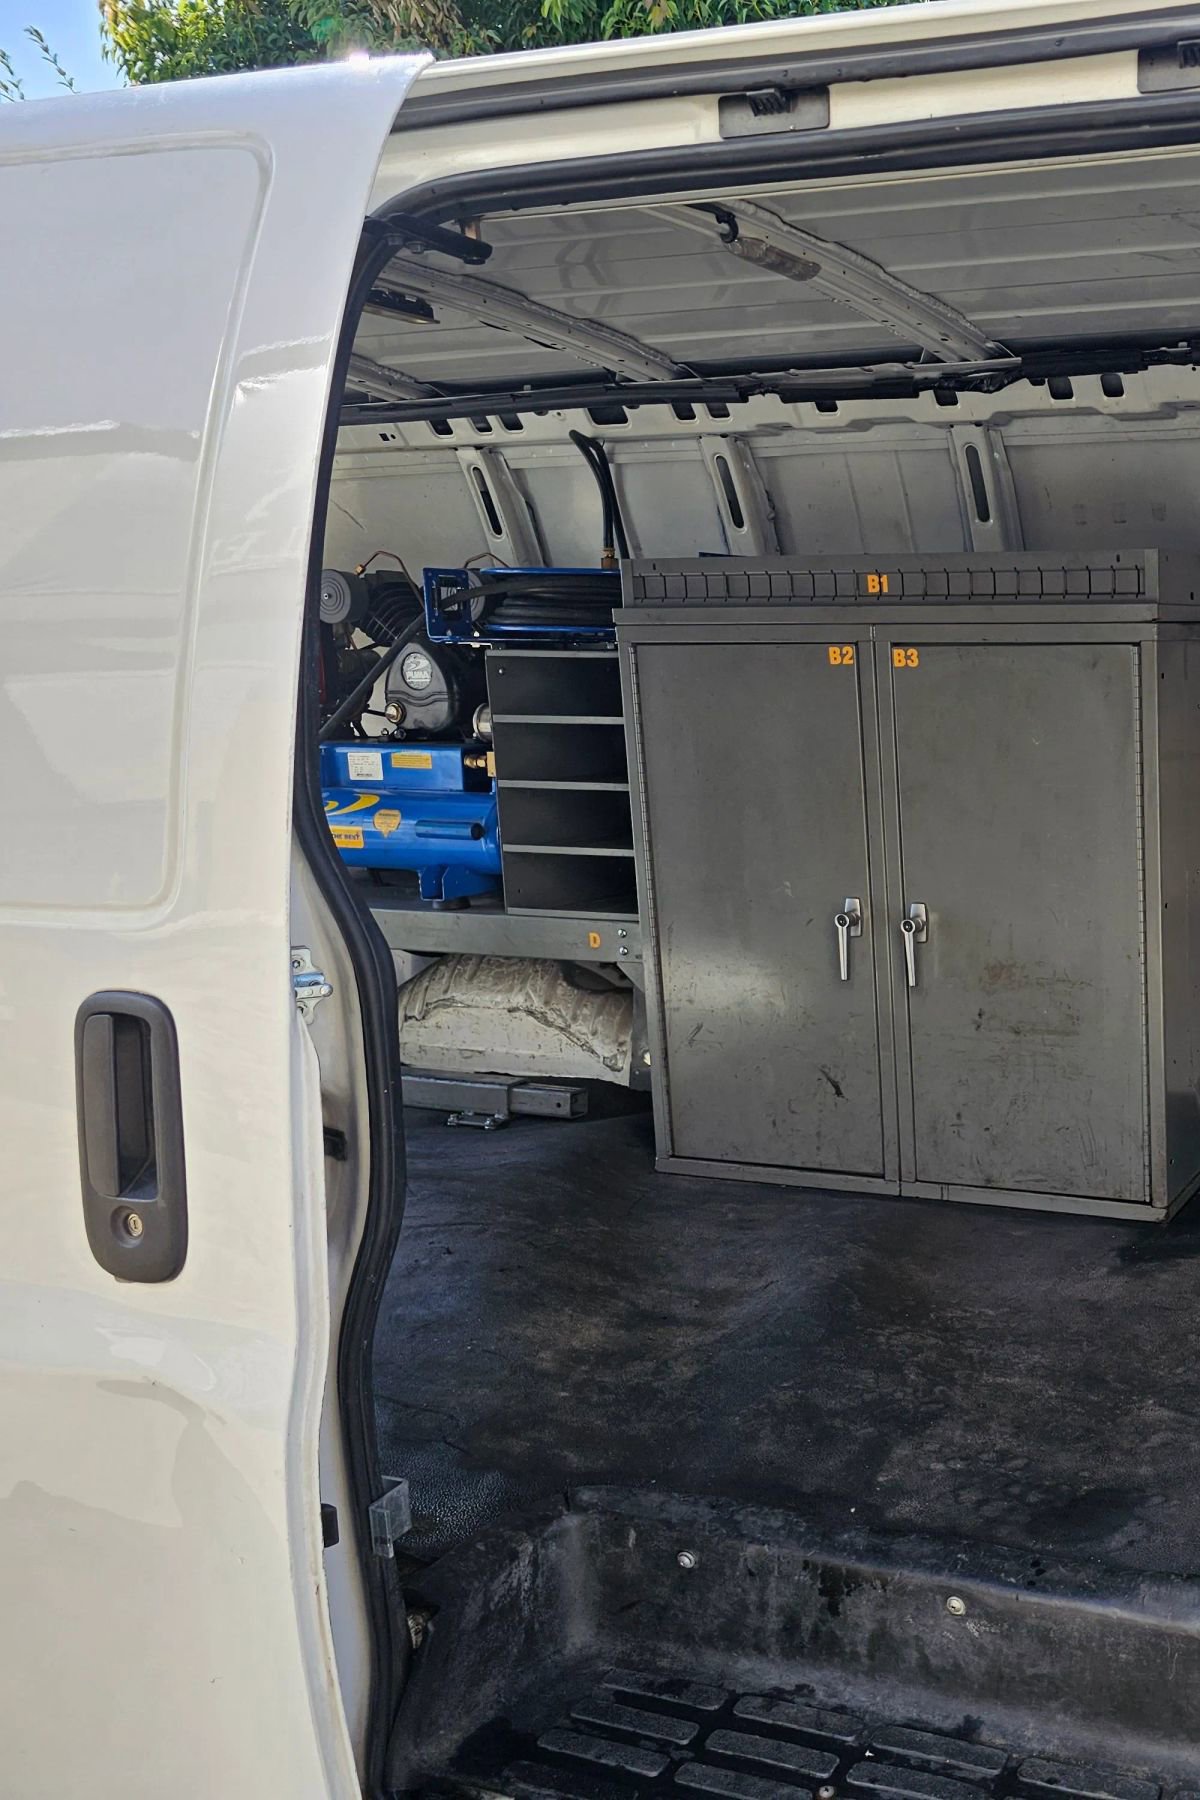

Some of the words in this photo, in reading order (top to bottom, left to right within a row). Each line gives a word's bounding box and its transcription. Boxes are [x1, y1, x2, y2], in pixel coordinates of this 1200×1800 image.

[867, 574, 888, 593] B1
[828, 646, 854, 665] B2
[893, 648, 919, 667] B3
[588, 932, 601, 949] D
